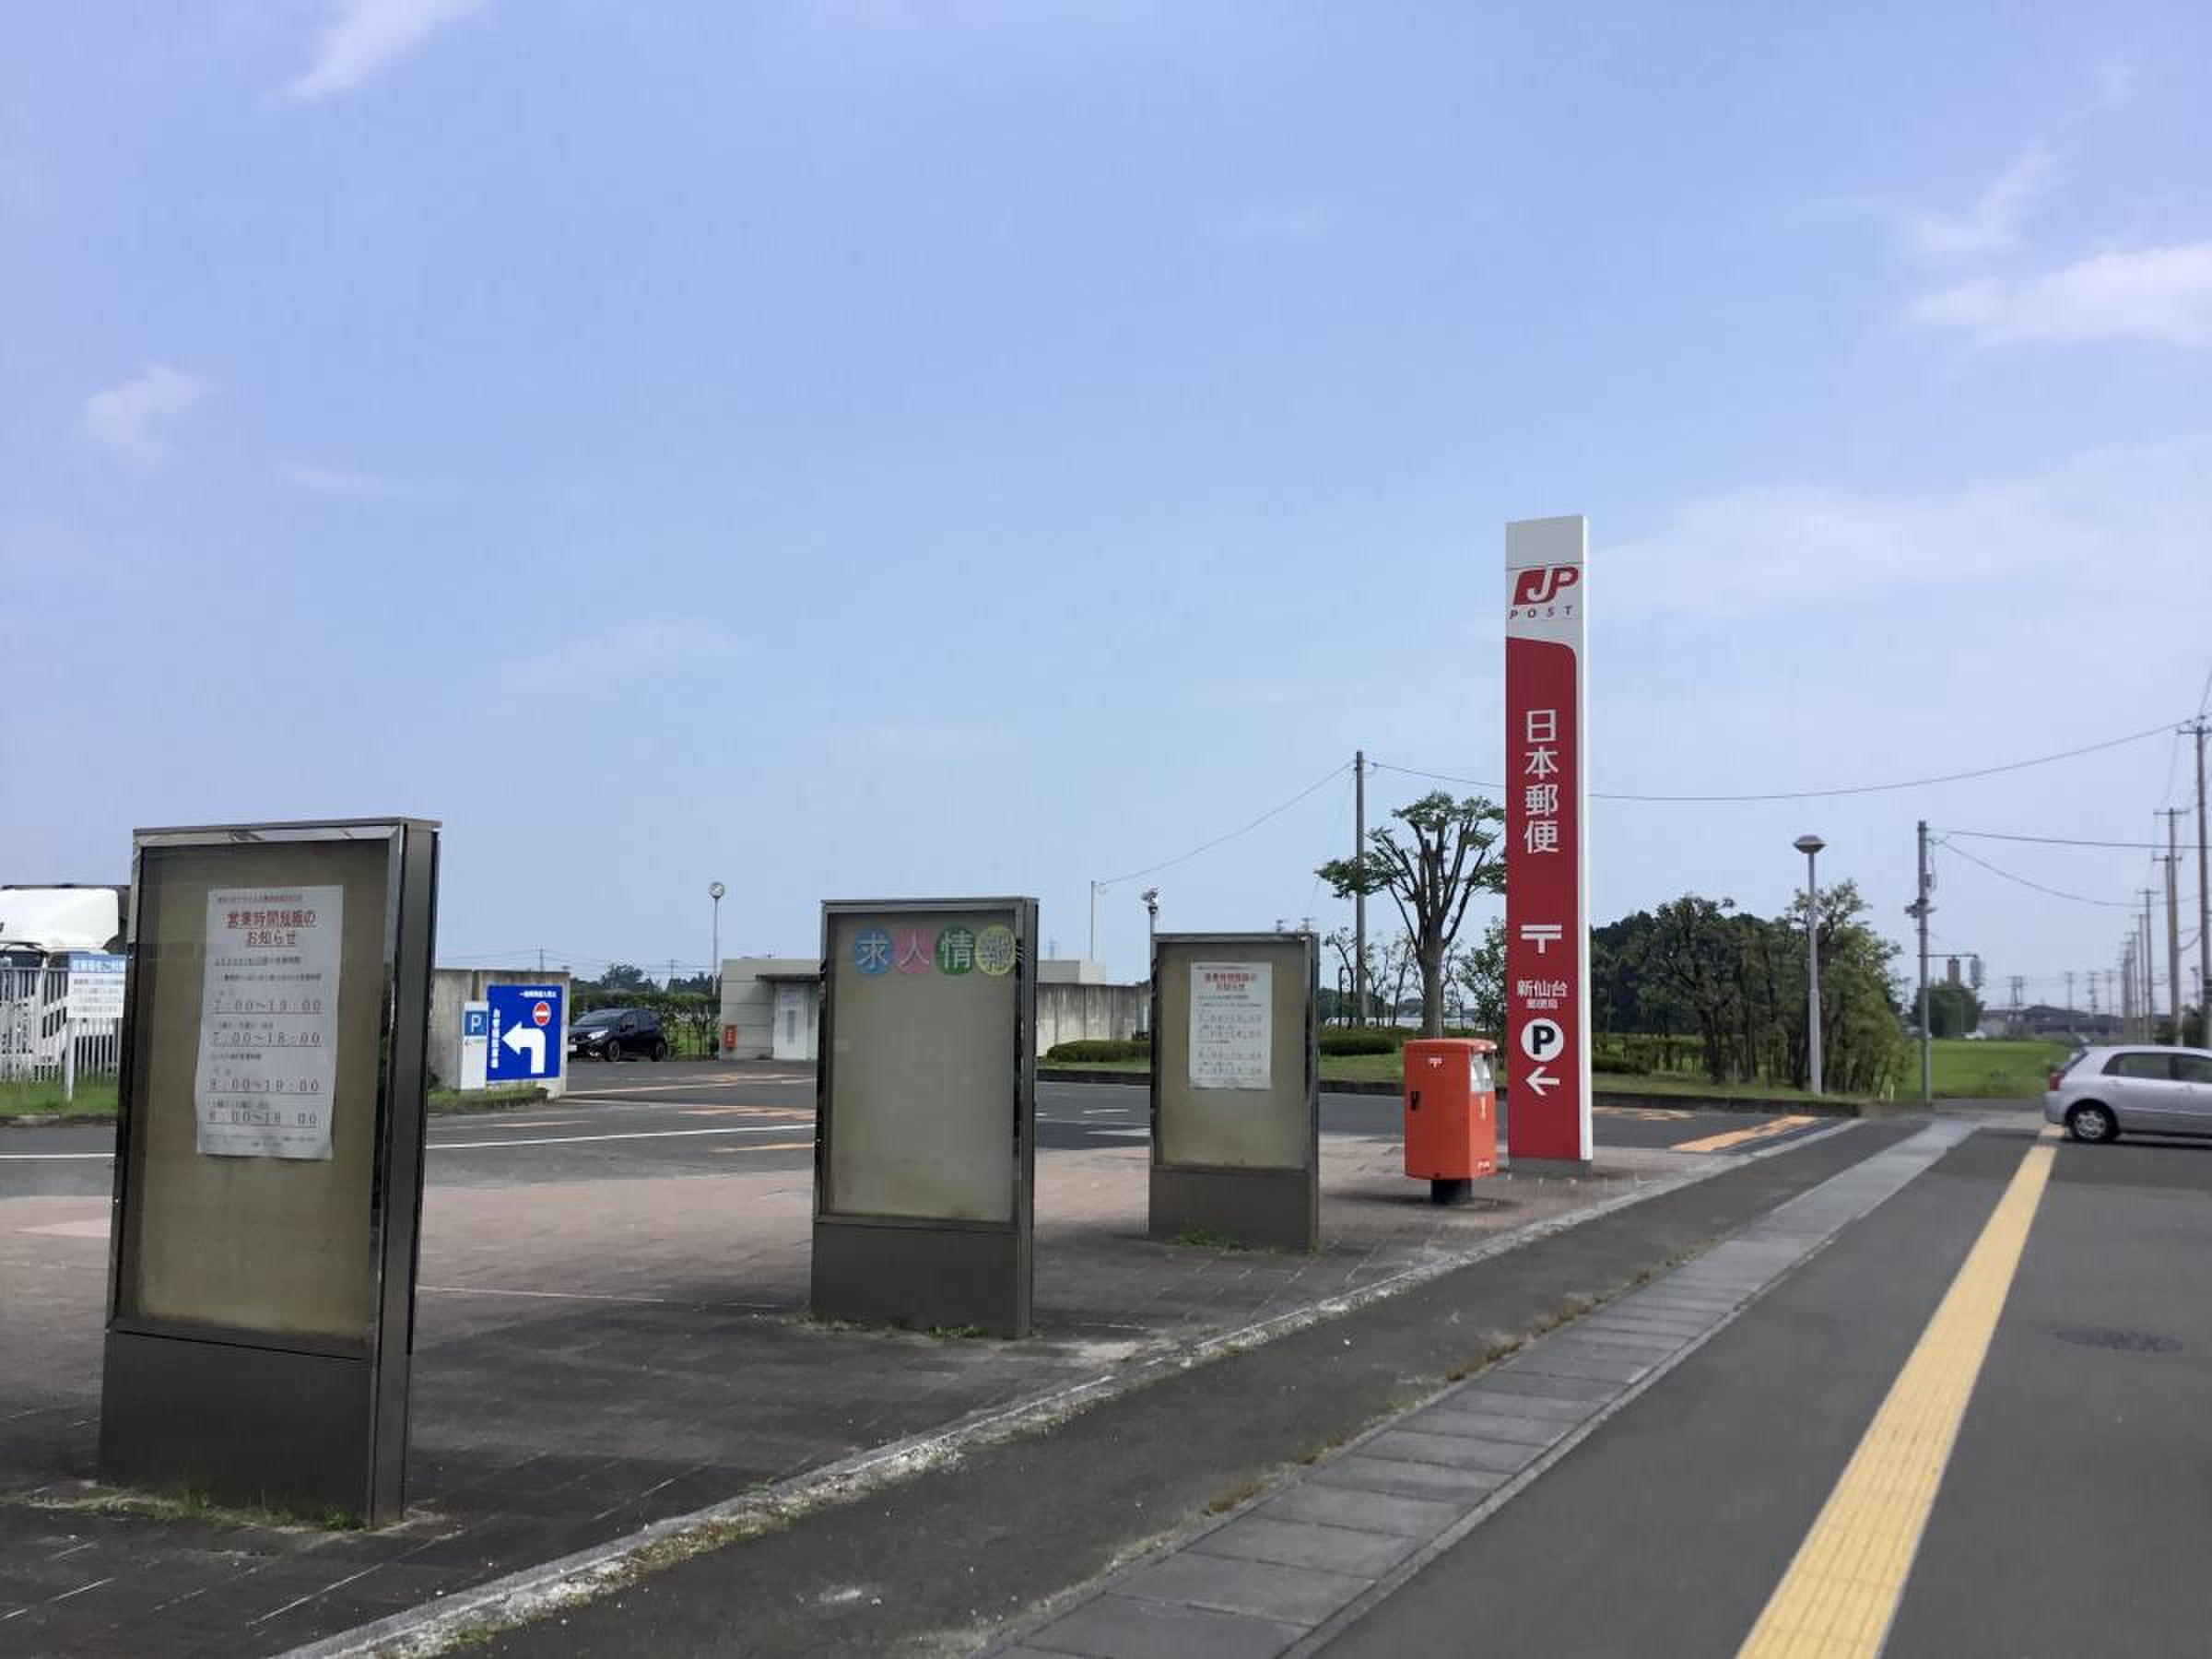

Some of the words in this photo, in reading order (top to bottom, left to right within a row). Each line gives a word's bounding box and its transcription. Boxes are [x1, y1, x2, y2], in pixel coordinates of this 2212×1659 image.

[1509, 605, 1573, 620] POST
[1524, 709, 1559, 854] 日本郵便
[1517, 980, 1568, 997] 新仙台
[471, 1015, 481, 1032] P
[1533, 1026, 1556, 1054] P
